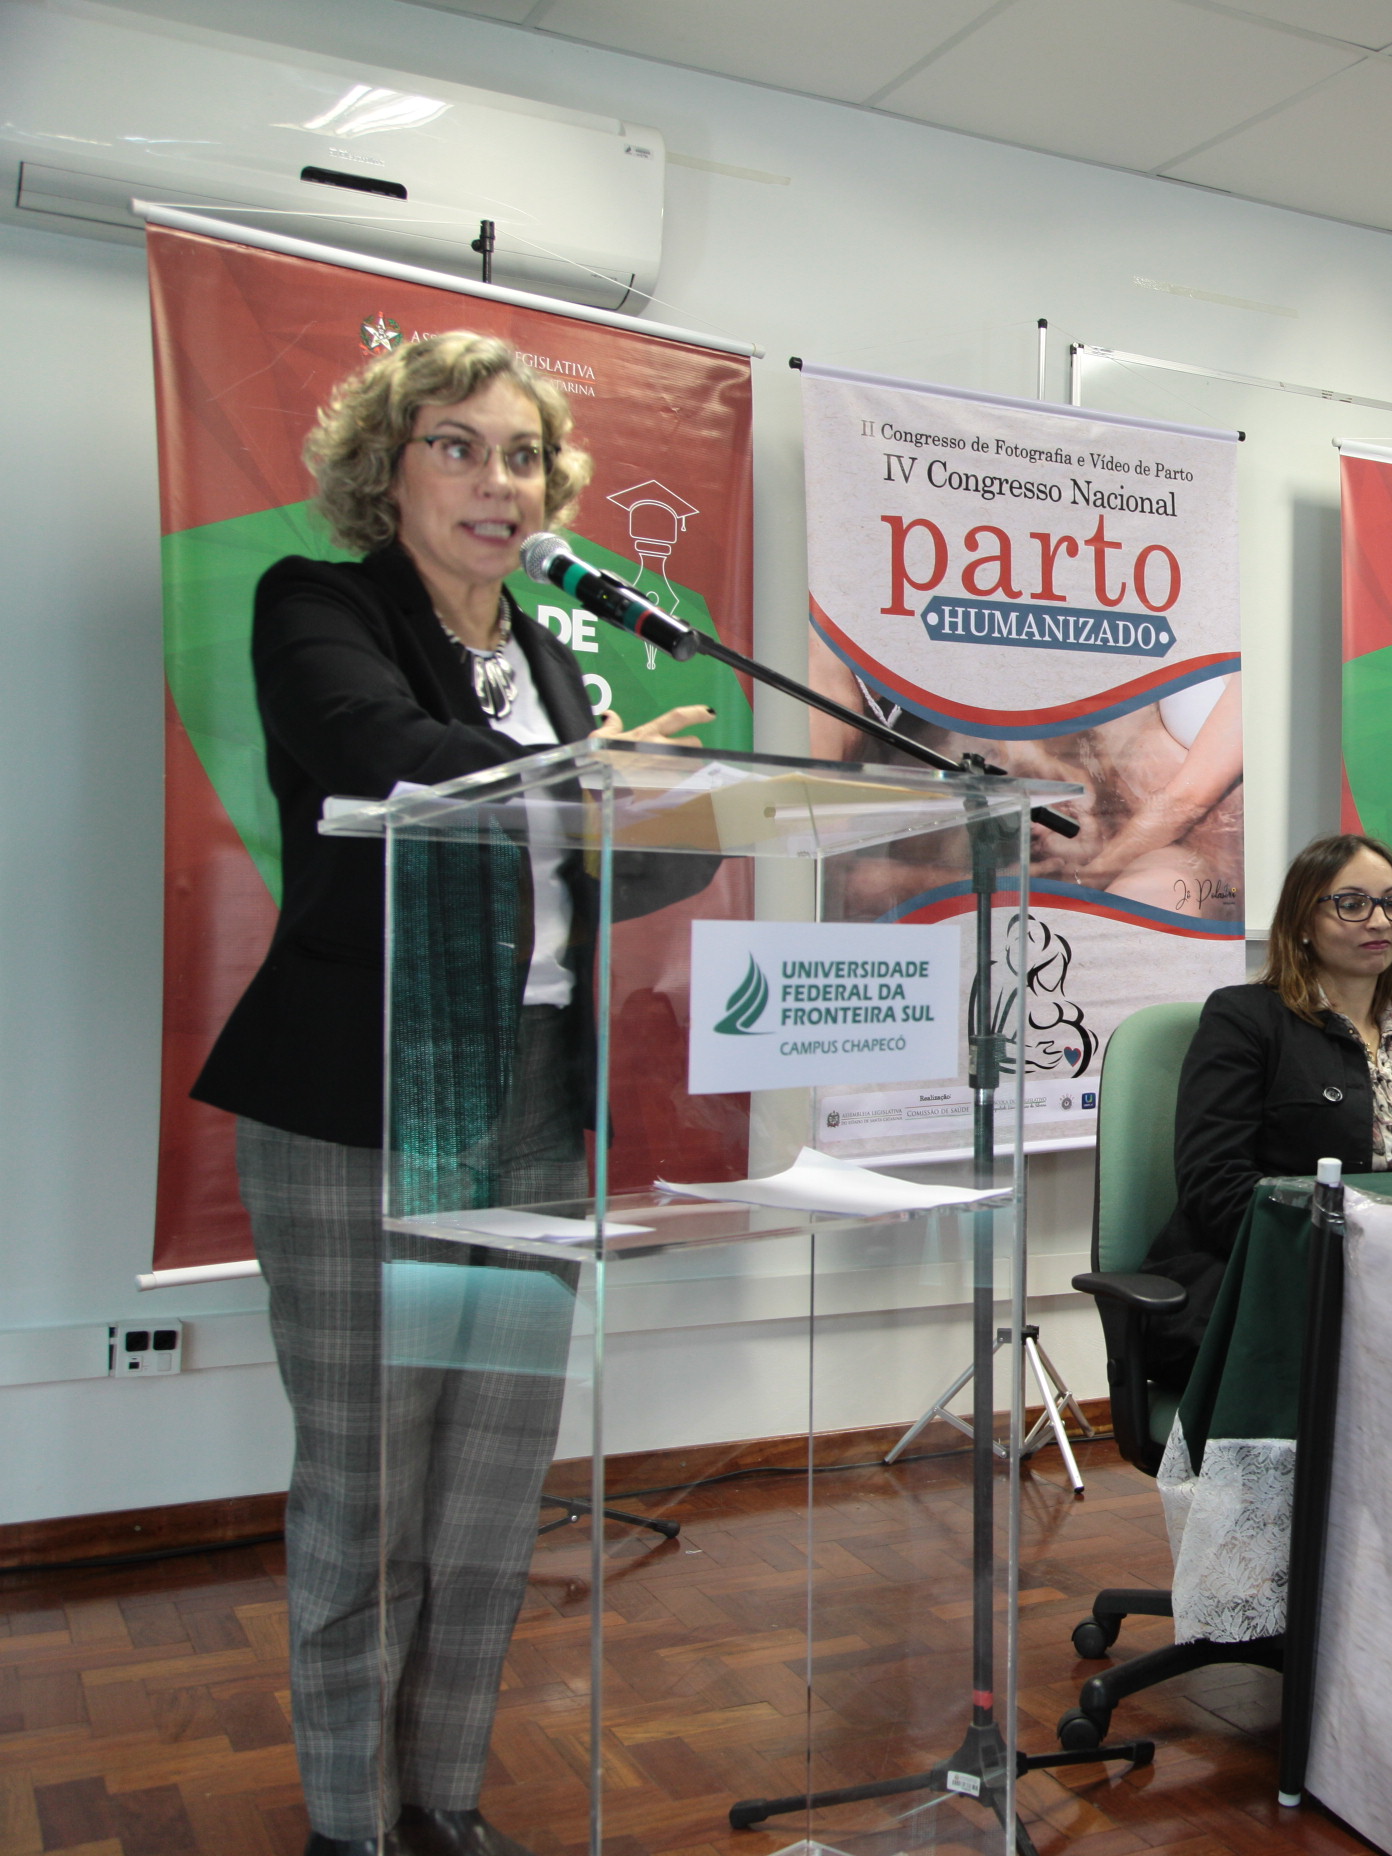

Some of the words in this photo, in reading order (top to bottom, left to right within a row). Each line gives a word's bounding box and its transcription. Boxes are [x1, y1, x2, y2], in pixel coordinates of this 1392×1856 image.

[516, 352, 595, 380] EGISLATIVA
[861, 420, 875, 438] II
[880, 423, 966, 451] Congresso
[971, 435, 990, 455] de
[995, 440, 1072, 467] Fotografia
[1077, 454, 1085, 467] e
[1090, 452, 1130, 474] Vídeo
[1134, 459, 1151, 477] de
[1155, 462, 1194, 482] Parto
[883, 453, 917, 483] IV
[927, 460, 1062, 501] Congresso
[1071, 479, 1177, 517] Nacional
[880, 514, 1182, 617] parto
[941, 605, 1156, 649] HUMANIZADO
[781, 960, 930, 978] UNIVERSIDADE
[781, 984, 872, 1002] FEDERAL
[878, 983, 906, 1000] DA
[780, 1006, 896, 1026] FRONTEIRA
[902, 1005, 934, 1022] SUL
[780, 1040, 837, 1056] CAMPUS
[841, 1034, 906, 1053] CHAPECÓ
